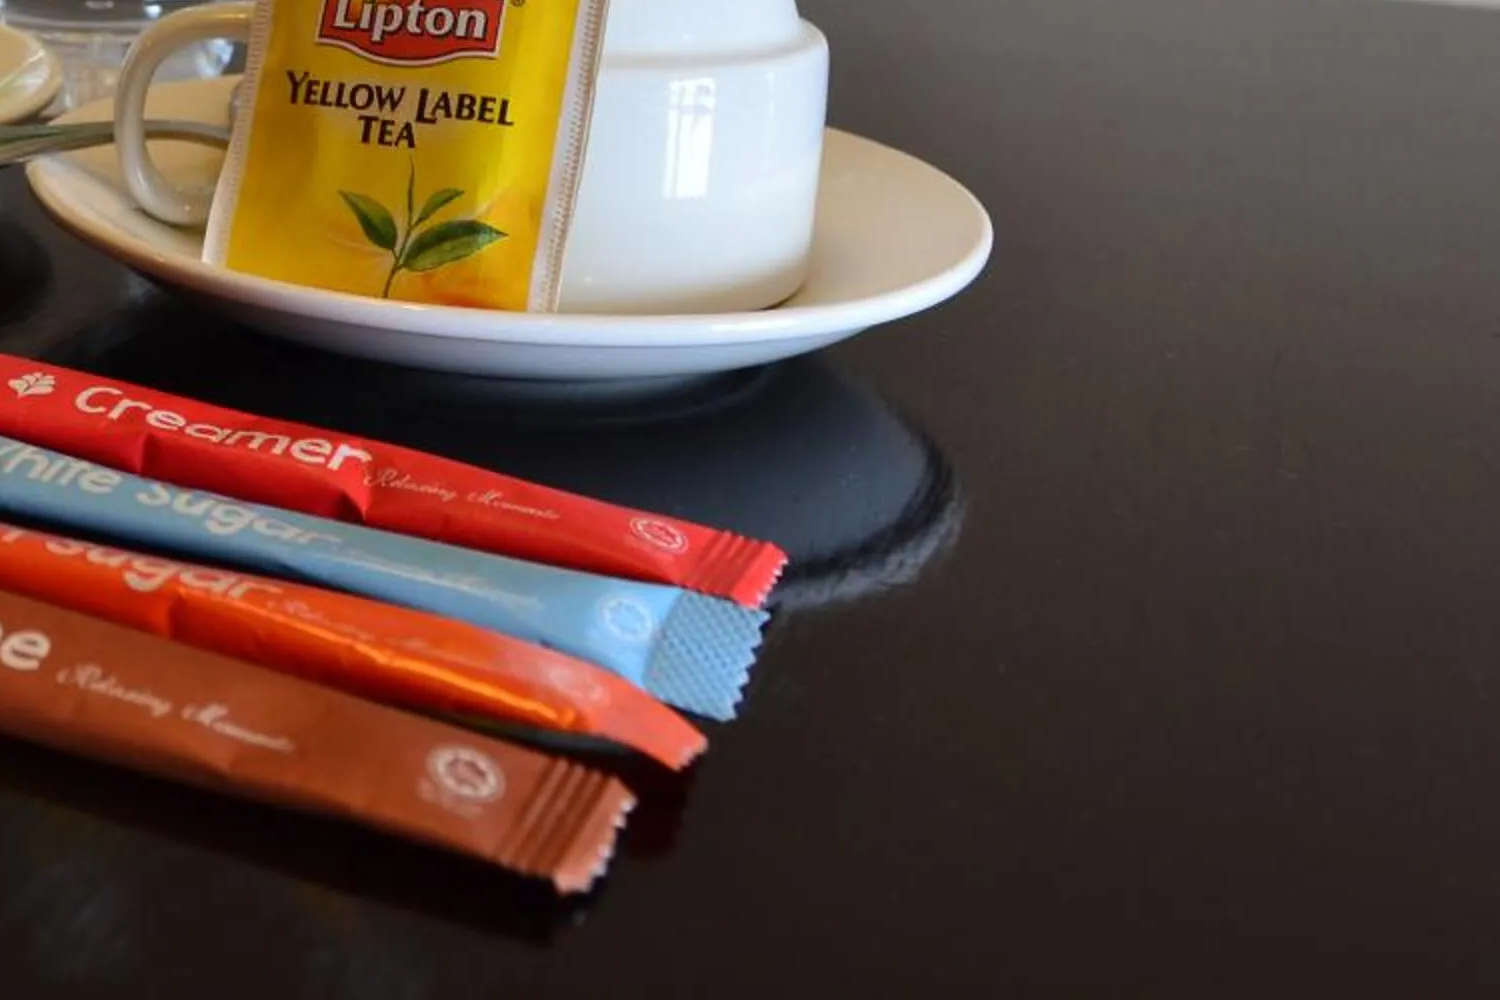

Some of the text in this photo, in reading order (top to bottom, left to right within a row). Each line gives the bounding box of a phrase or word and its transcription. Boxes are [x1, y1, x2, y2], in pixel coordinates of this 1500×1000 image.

[285, 70, 515, 127] YELLOW LABEL
[357, 115, 416, 149] TEA
[74, 384, 374, 472] Creamer
[134, 481, 342, 545] Sugar
